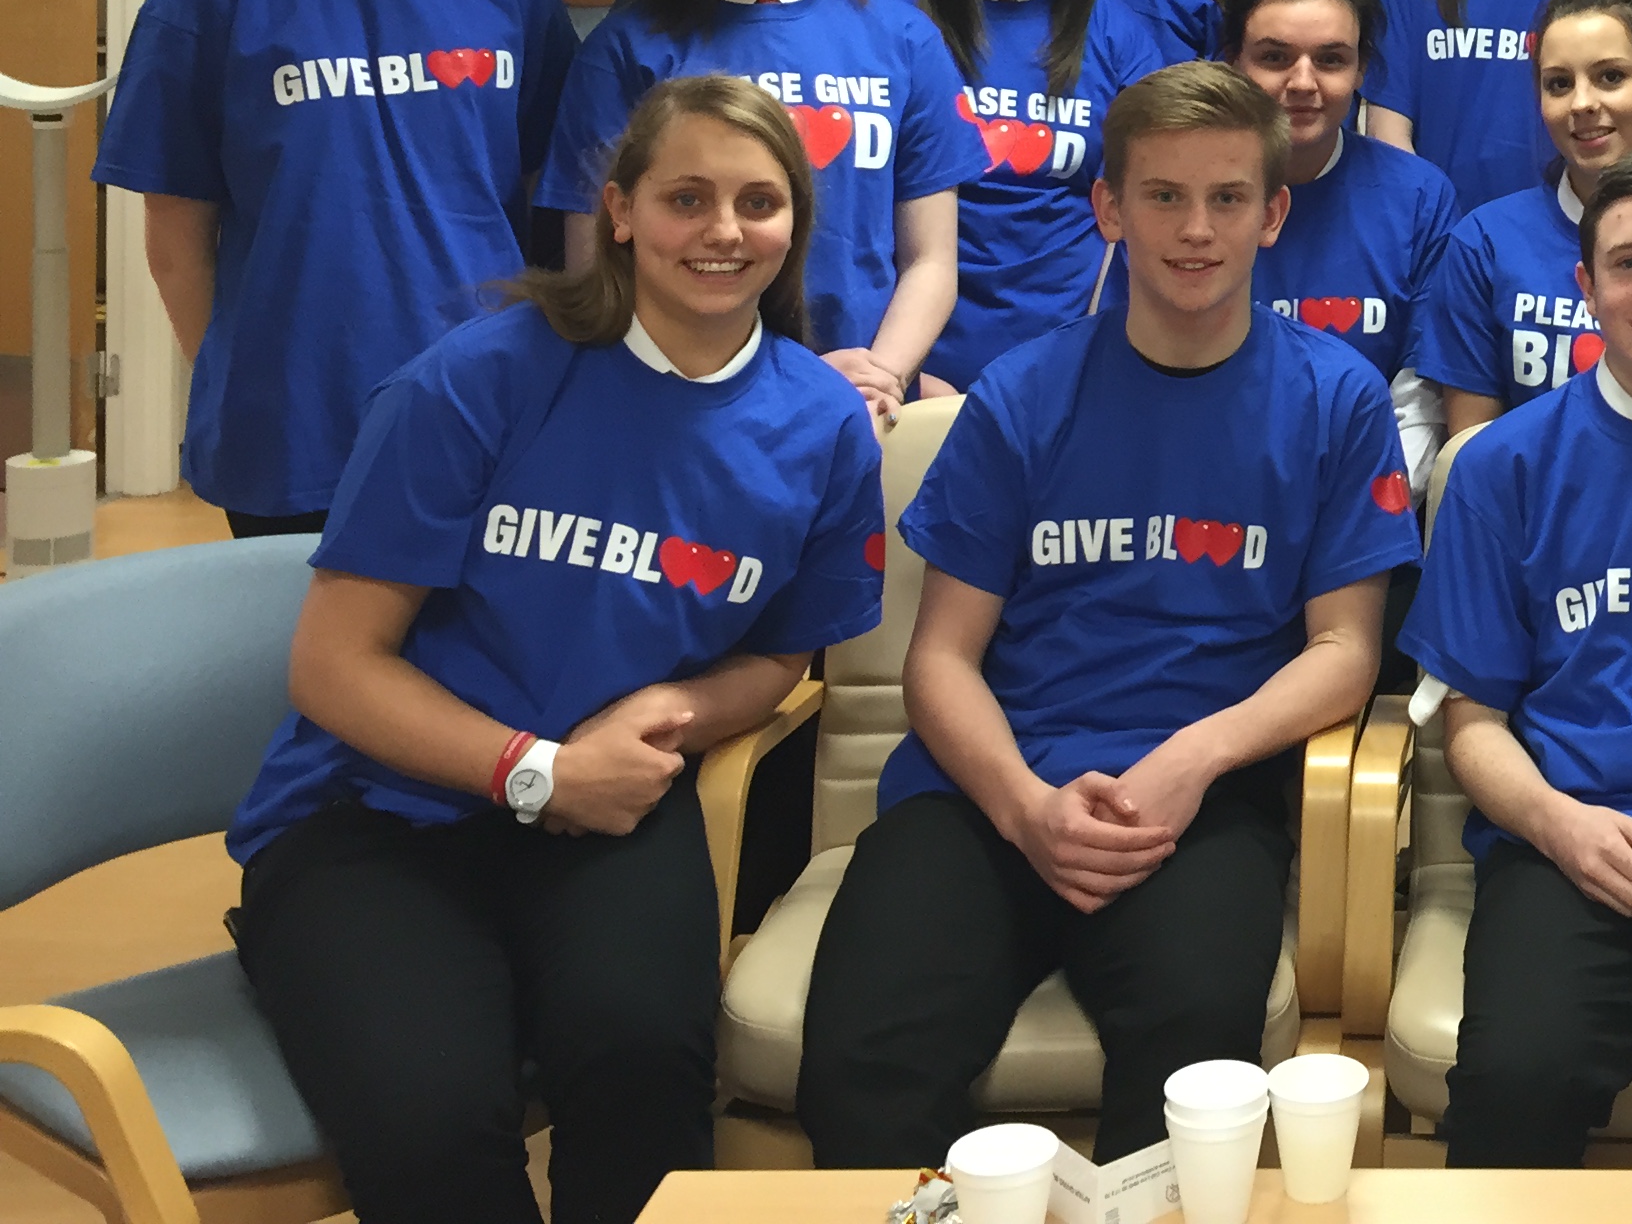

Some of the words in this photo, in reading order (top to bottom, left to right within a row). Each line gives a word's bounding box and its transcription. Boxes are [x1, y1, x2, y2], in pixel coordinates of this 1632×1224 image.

[1427, 28, 1492, 60] GIVE
[273, 57, 374, 106] GIVE
[815, 74, 891, 107] GIVE
[1028, 92, 1092, 127] GIVE
[1513, 292, 1601, 329] PLEA
[483, 504, 602, 567] GIVE
[1032, 517, 1134, 567] GIVE
[1556, 568, 1631, 633] GIVE
